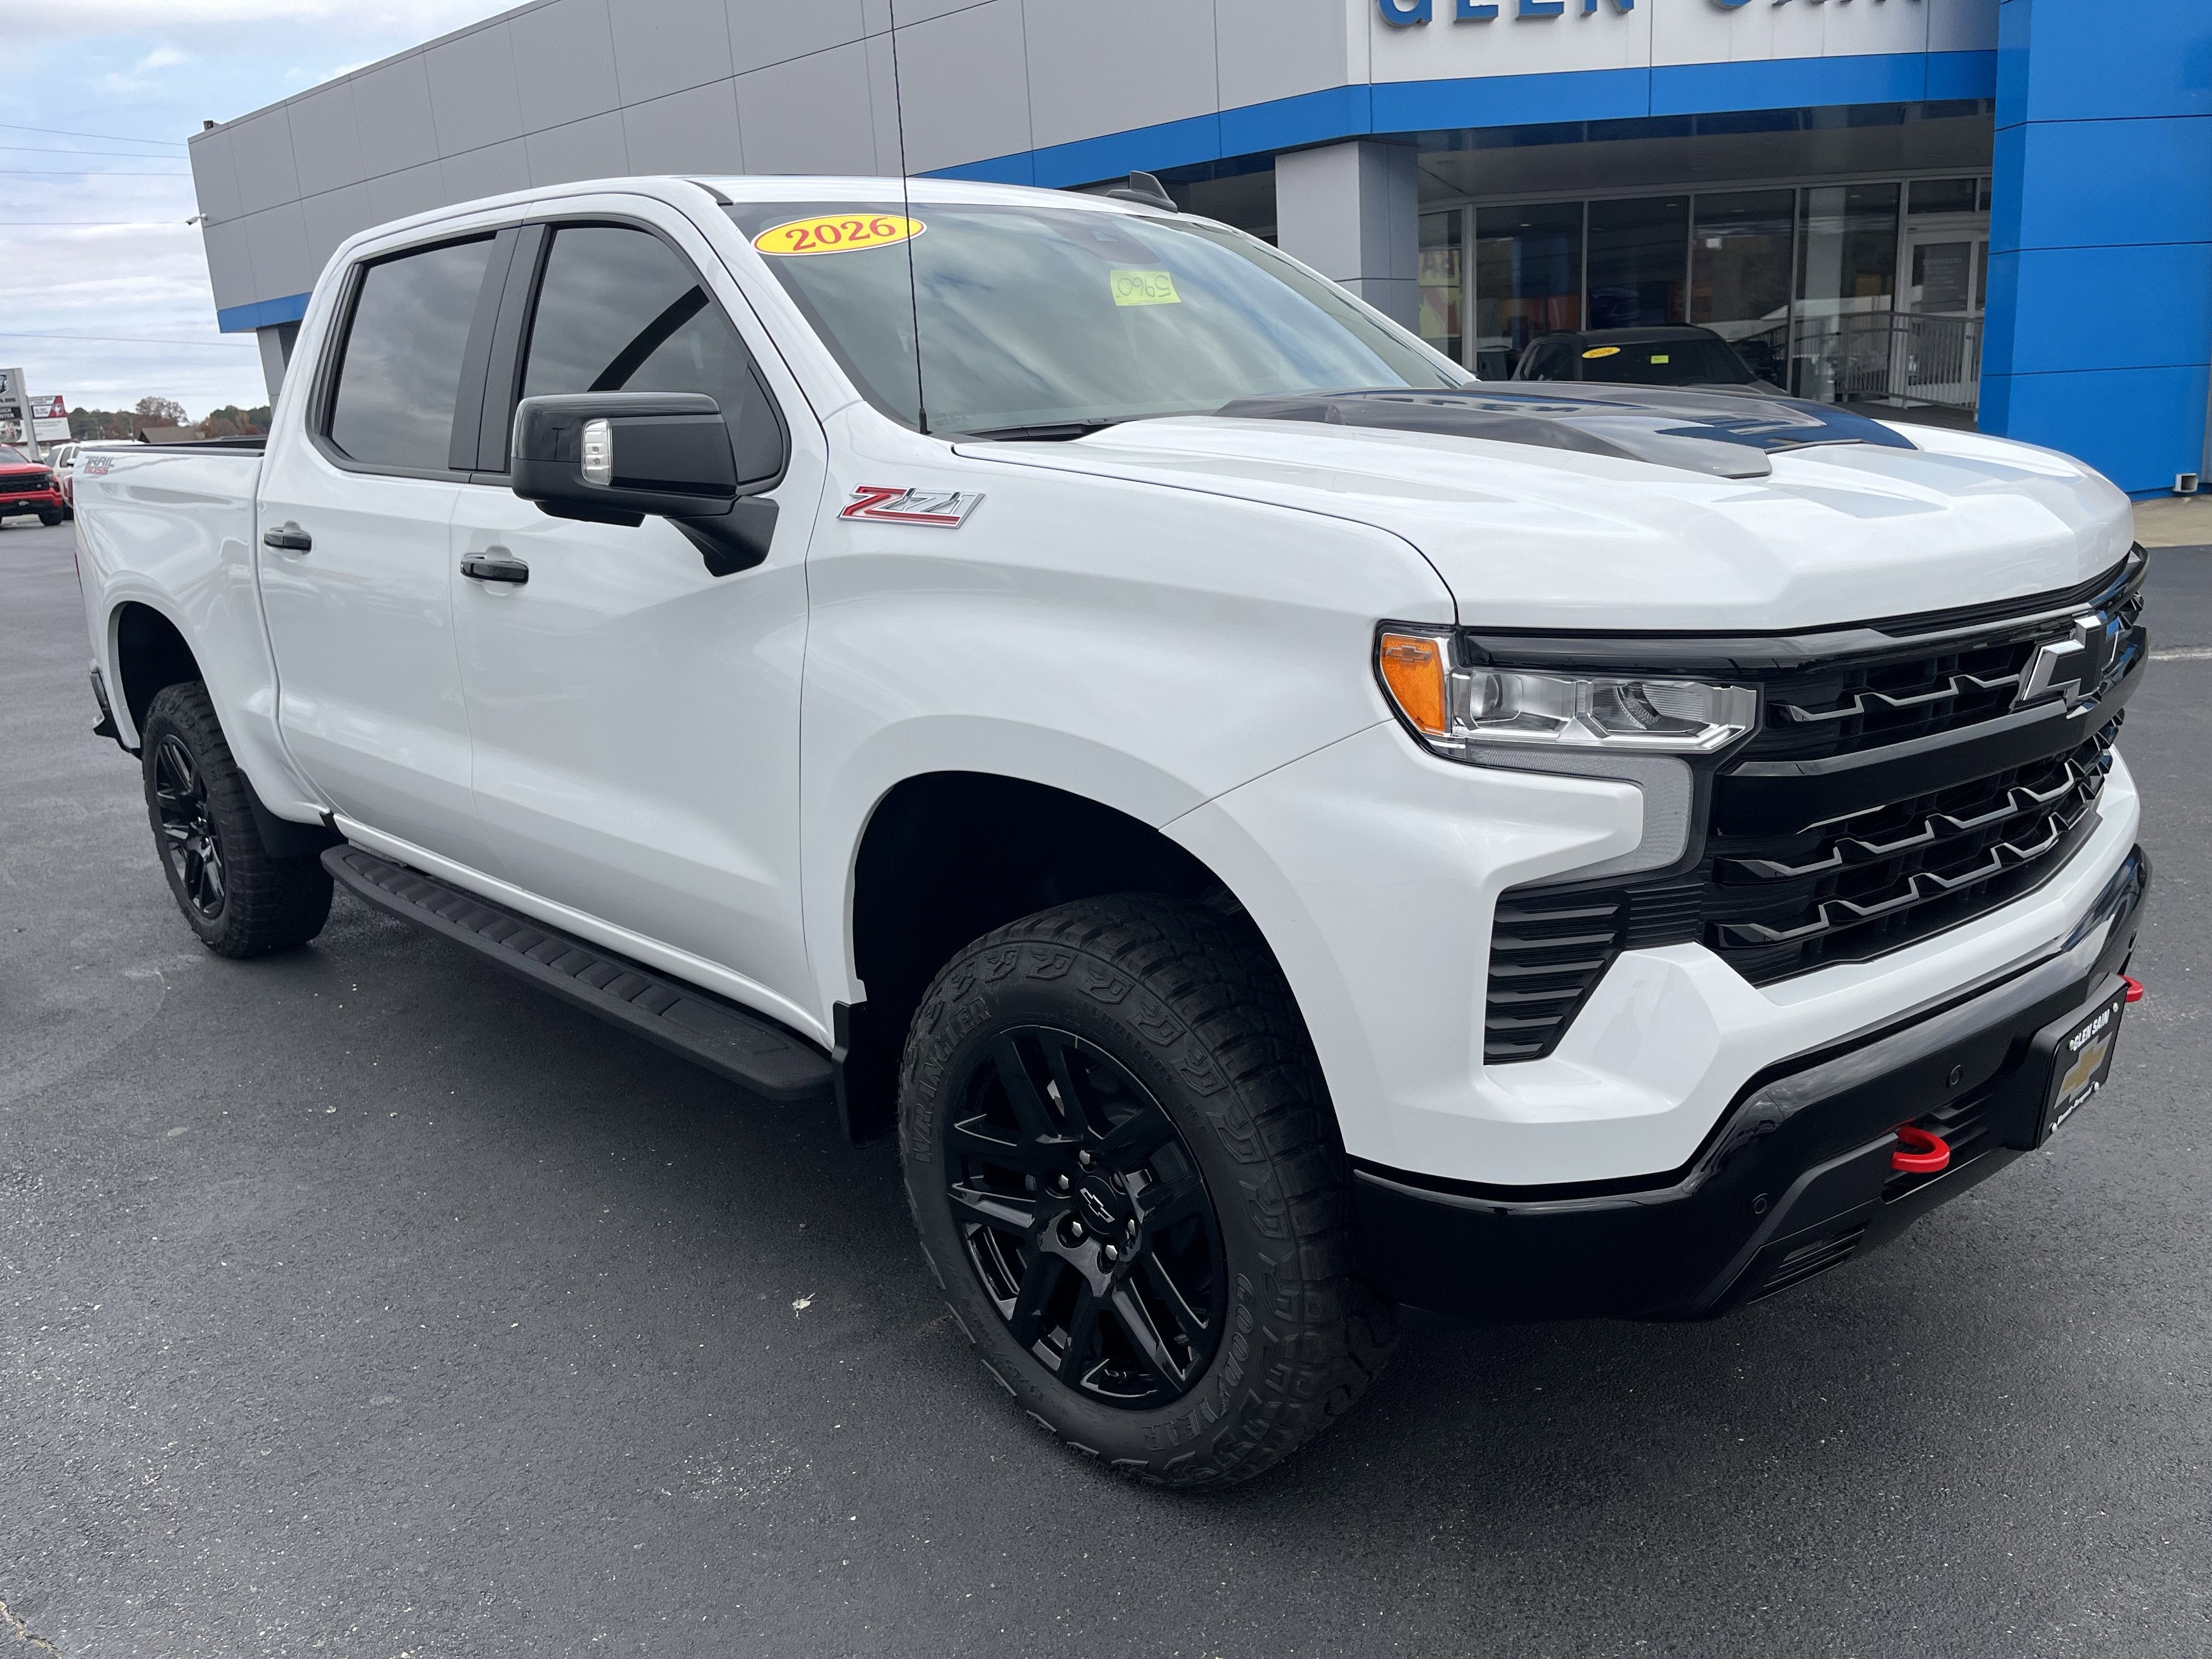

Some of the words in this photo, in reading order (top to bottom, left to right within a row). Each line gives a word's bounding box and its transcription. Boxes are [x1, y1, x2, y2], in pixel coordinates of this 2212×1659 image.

[785, 217, 896, 251] 2026
[83, 465, 110, 475] BOSS
[85, 455, 115, 467] TRAIL
[836, 482, 986, 529] Z71
[2073, 1023, 2093, 1052] GLEN
[2092, 1008, 2110, 1035] SAIN
[912, 997, 992, 1163] WRANGLER
[1142, 1273, 1255, 1451] GOODYEAR
